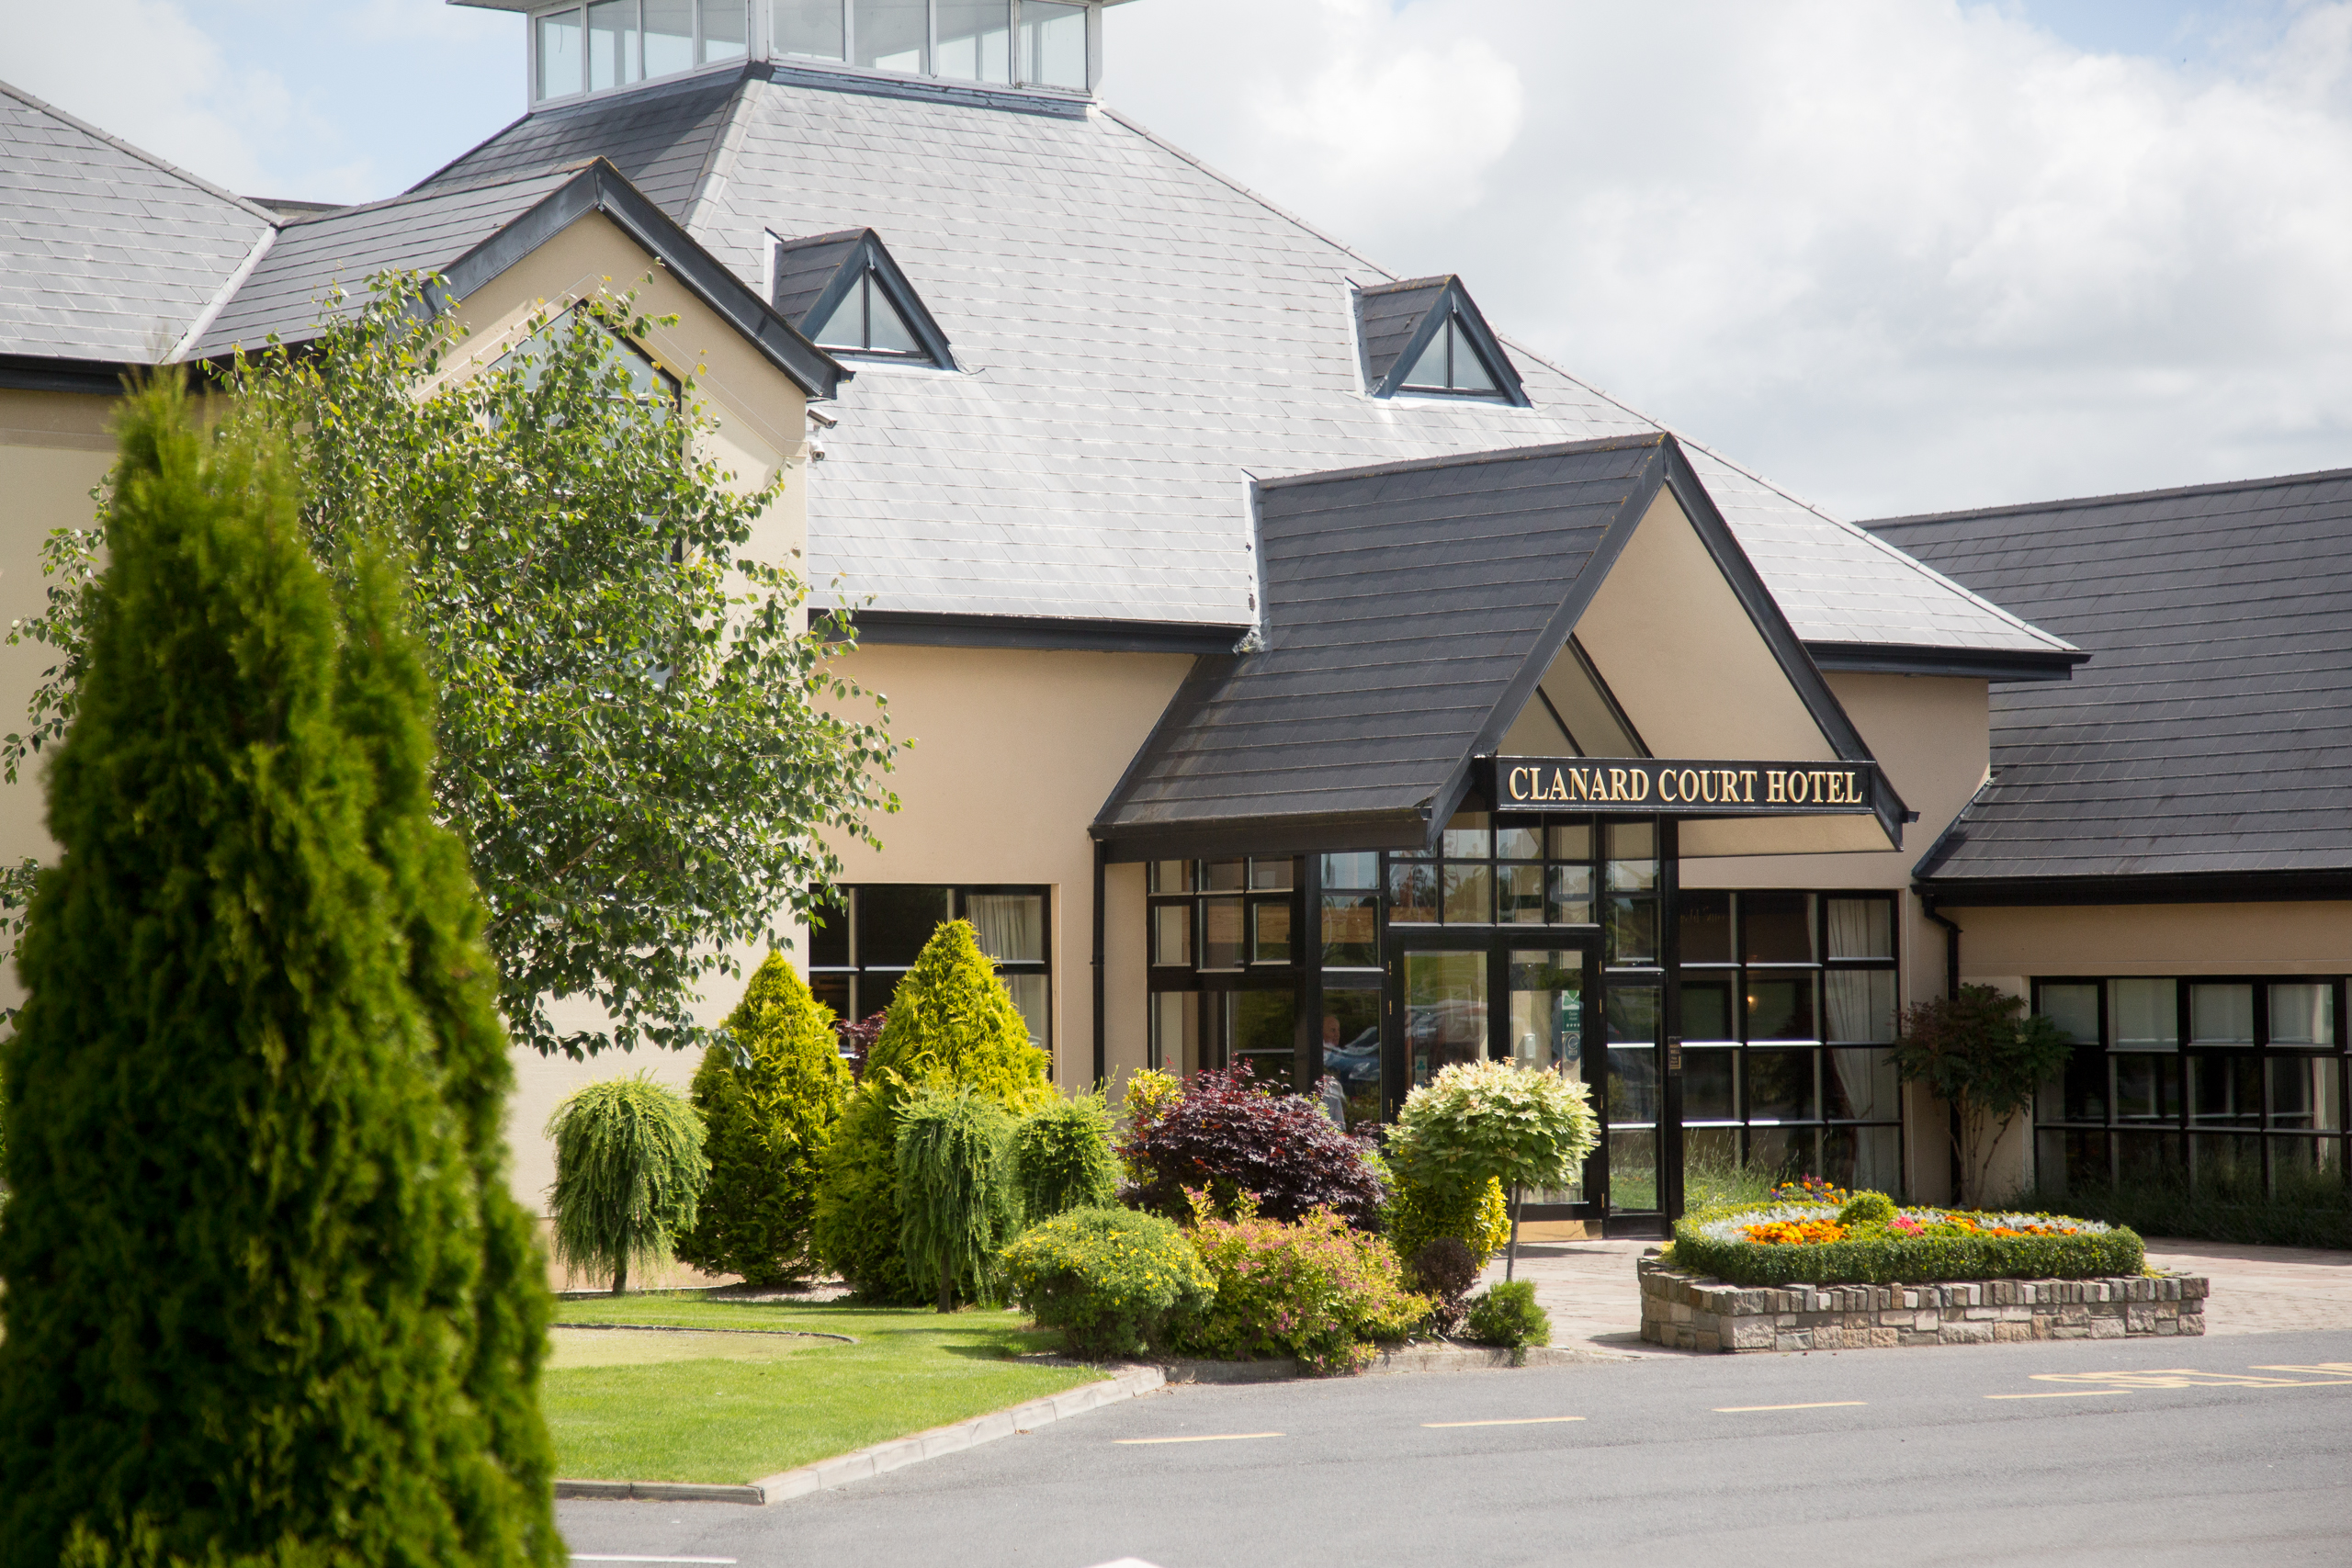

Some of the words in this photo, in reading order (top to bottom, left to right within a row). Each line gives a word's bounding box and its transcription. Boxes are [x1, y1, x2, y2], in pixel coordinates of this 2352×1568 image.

[1509, 766, 1650, 802] CLANARD
[1658, 768, 1758, 803] COURT
[1767, 771, 1863, 804] HOTEL
